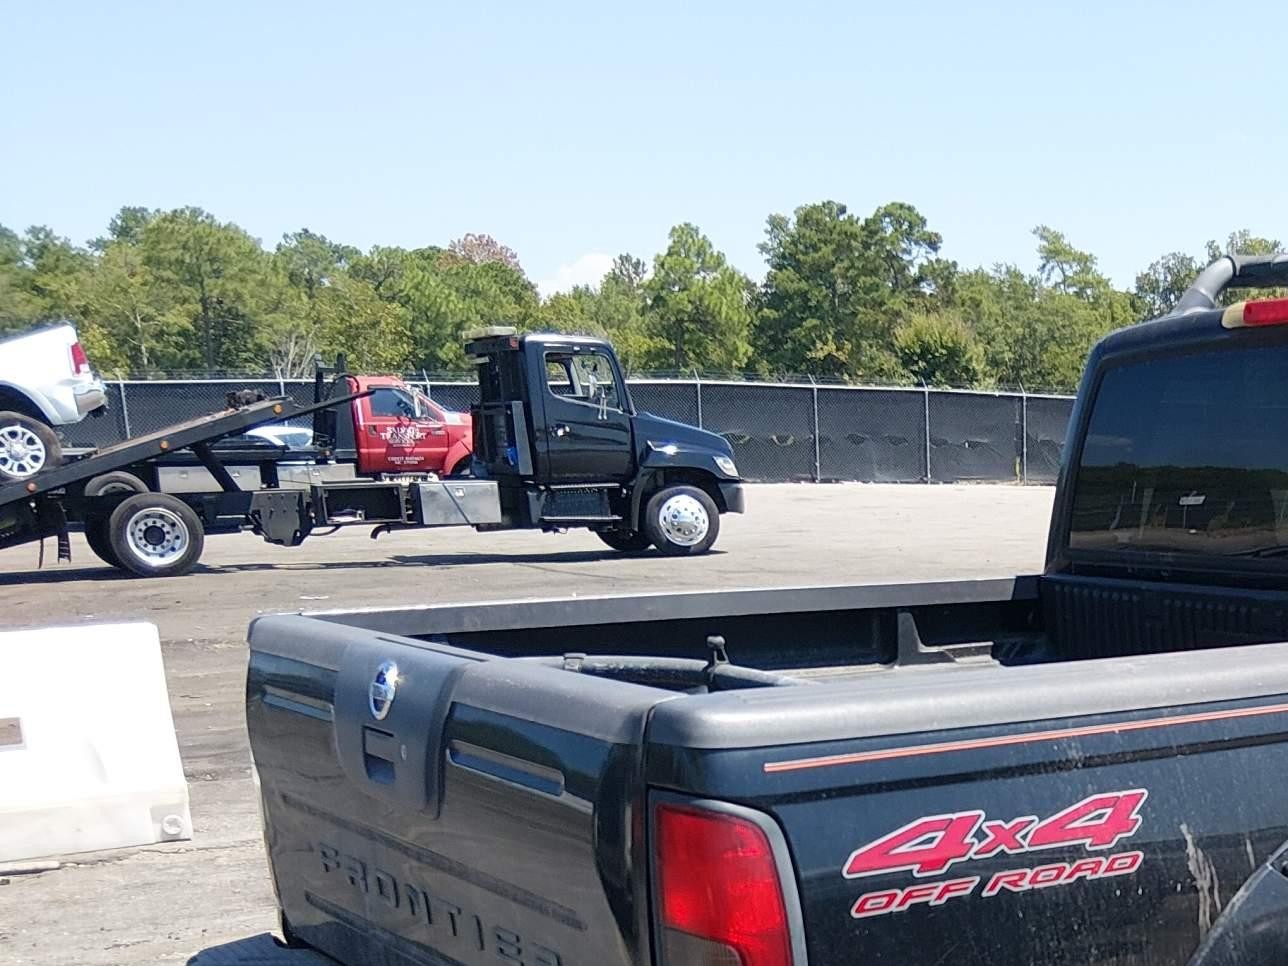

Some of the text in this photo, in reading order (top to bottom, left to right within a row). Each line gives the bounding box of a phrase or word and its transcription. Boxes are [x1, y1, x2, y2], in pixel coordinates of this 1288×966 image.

[841, 787, 1149, 880] 4x4
[849, 850, 1145, 919] OFF ROAD
